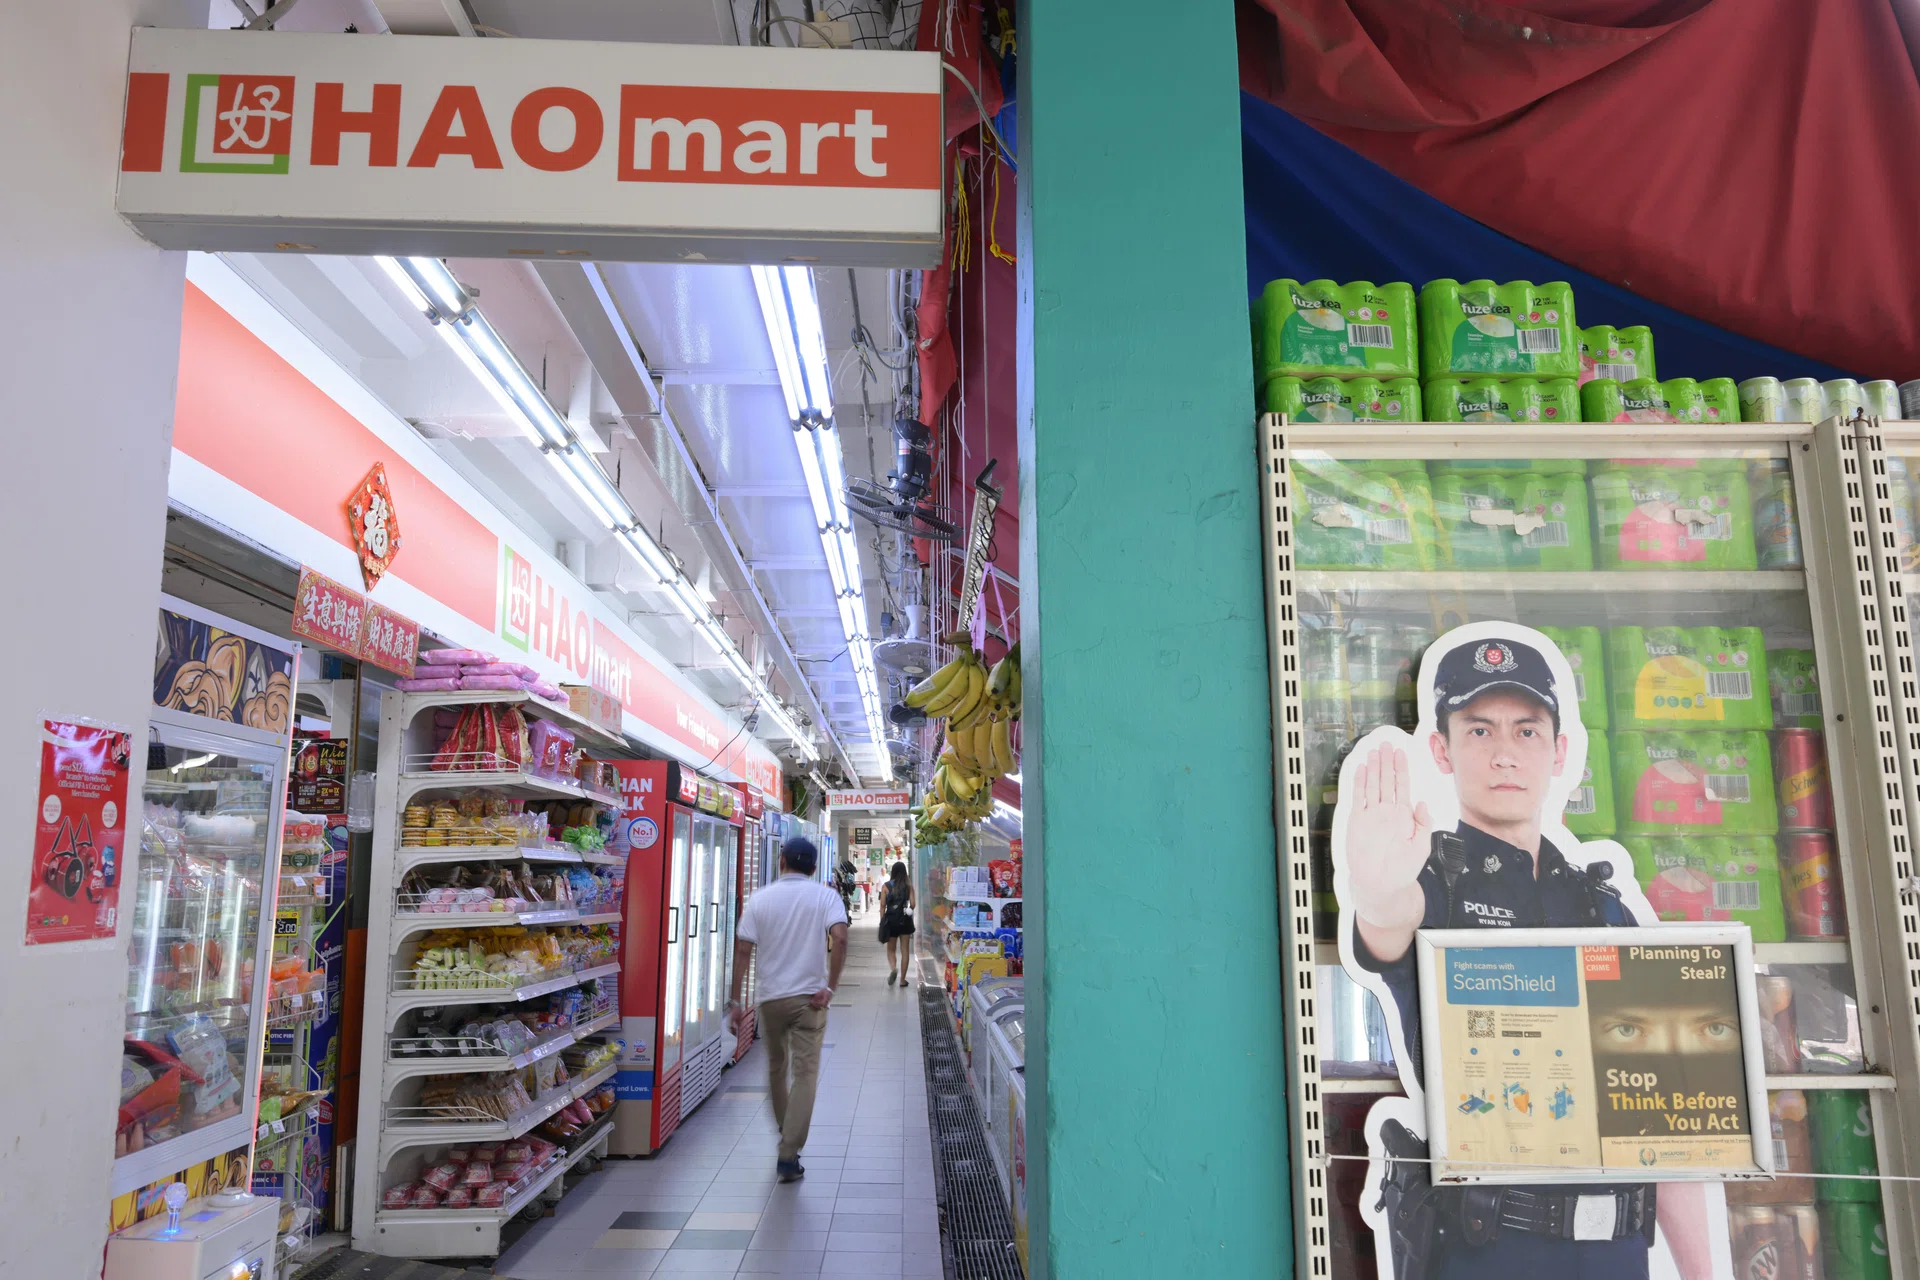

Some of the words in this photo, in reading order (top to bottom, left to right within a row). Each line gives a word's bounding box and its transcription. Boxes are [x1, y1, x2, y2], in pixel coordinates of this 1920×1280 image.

[219, 83, 291, 151] 好
[310, 82, 604, 171] HAO
[633, 109, 888, 177] mart
[1291, 294, 1342, 310] fuzetea
[1362, 294, 1374, 304] 12
[1462, 303, 1511, 314] fuzetea
[1532, 298, 1542, 306] 12
[592, 643, 632, 706] mart
[619, 778, 652, 792] HAN
[844, 794, 874, 804] HAO
[876, 795, 904, 804] mart
[632, 828, 653, 836] No.1
[1464, 901, 1516, 919] POLICE
[1478, 918, 1496, 926] RYAN
[1630, 946, 1700, 962] Planning
[1703, 946, 1721, 959] To
[1454, 962, 1472, 971] Fight
[1681, 966, 1726, 980] Steal?
[1453, 974, 1556, 992] ScamShield
[1606, 1069, 1657, 1091] Stop
[1608, 1092, 1668, 1110] Think
[1672, 1092, 1737, 1110] Before
[1664, 1113, 1701, 1131] You
[1707, 1113, 1739, 1130] Act
